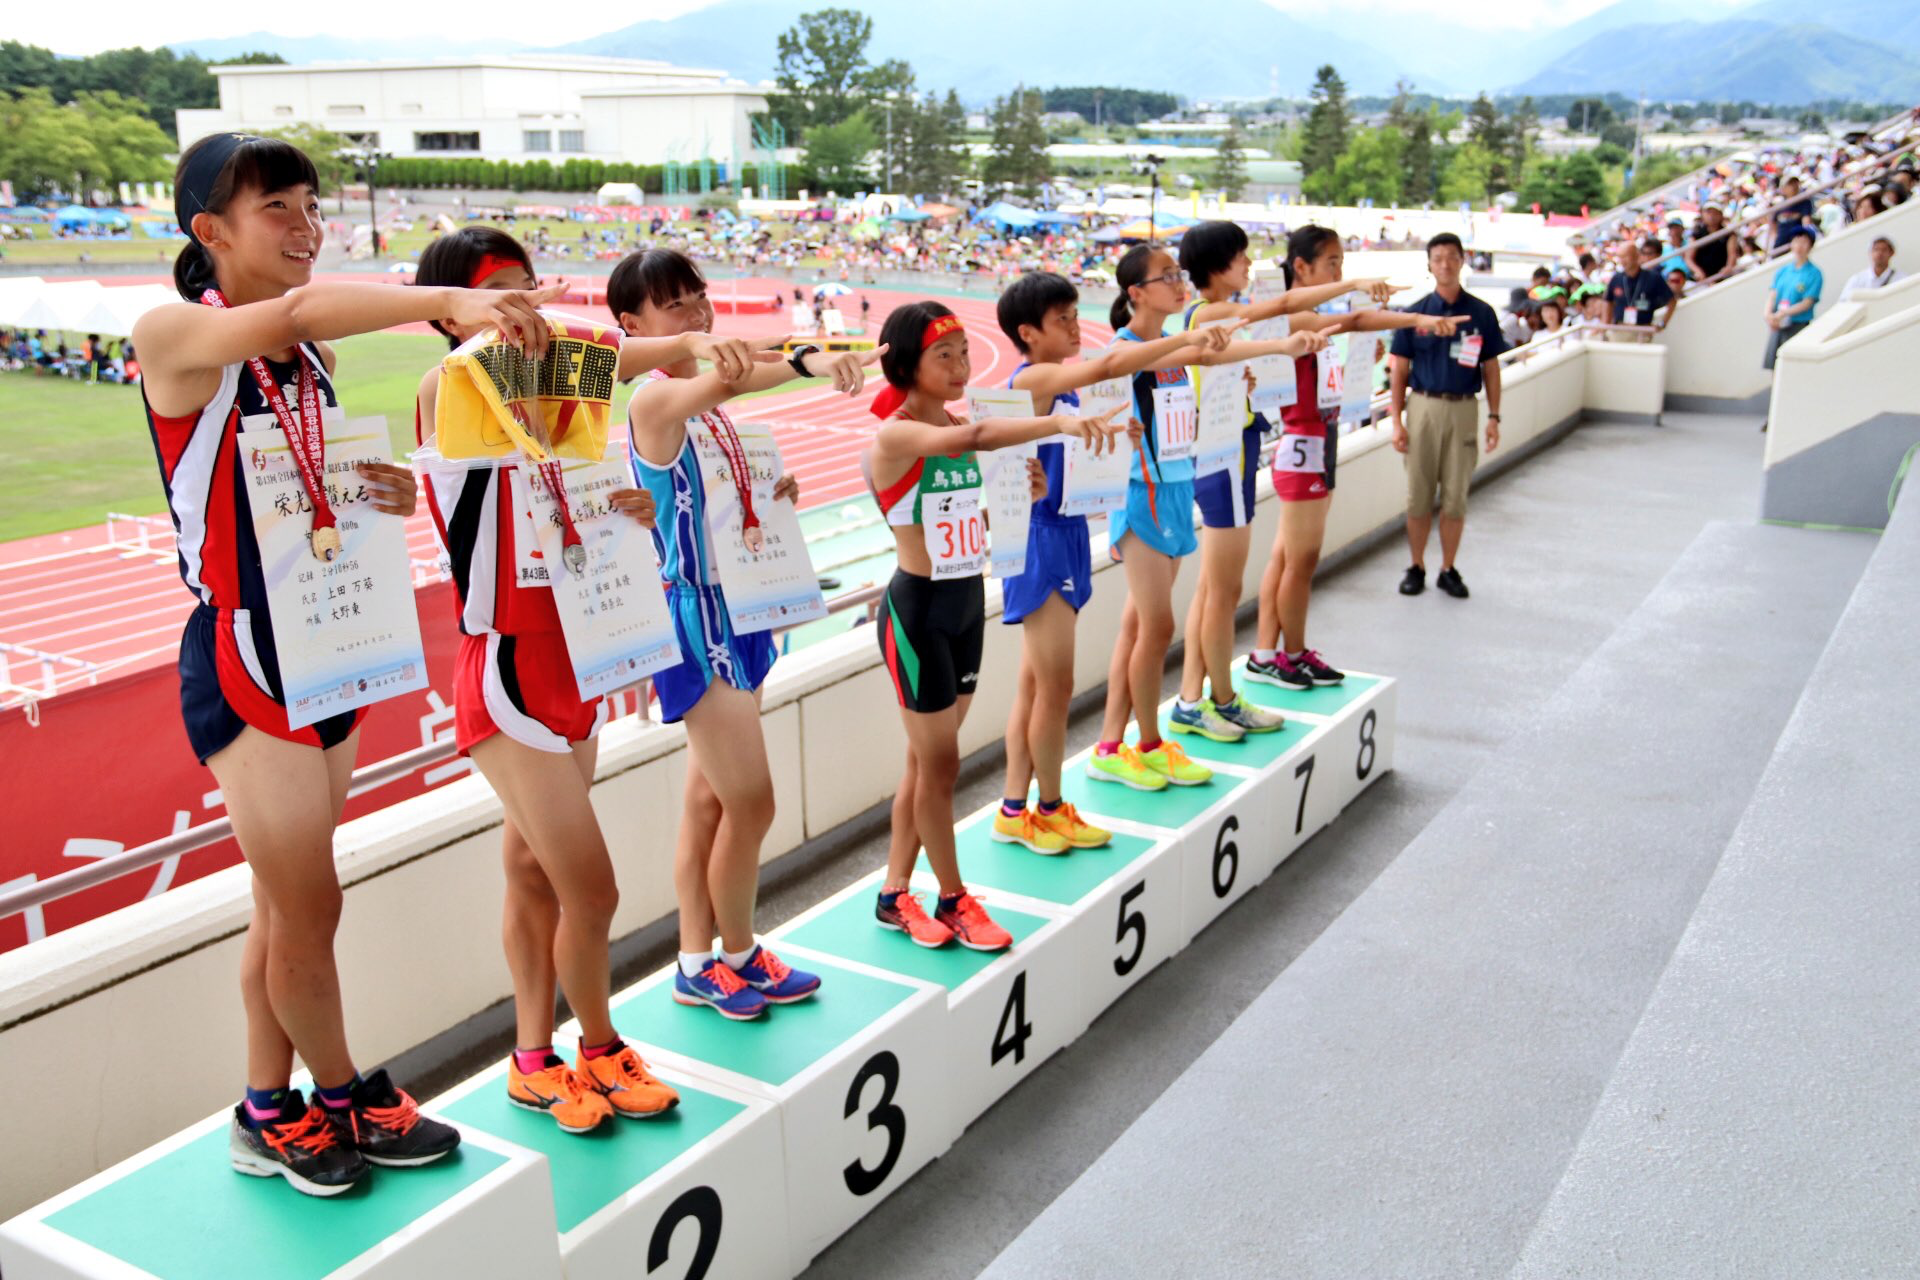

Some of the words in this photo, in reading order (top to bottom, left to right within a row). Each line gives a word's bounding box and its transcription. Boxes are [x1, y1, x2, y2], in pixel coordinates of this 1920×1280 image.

[932, 467, 979, 489] 鳥取西
[1292, 439, 1309, 468] 5
[328, 585, 346, 600] 上田
[331, 602, 362, 621] 大野東
[1356, 708, 1377, 781] 8
[1294, 754, 1316, 836] 7
[1212, 815, 1240, 899] 6
[1113, 880, 1147, 977] 5
[990, 970, 1033, 1067] 4
[842, 1050, 907, 1196] 3
[646, 1185, 723, 1280] 2
